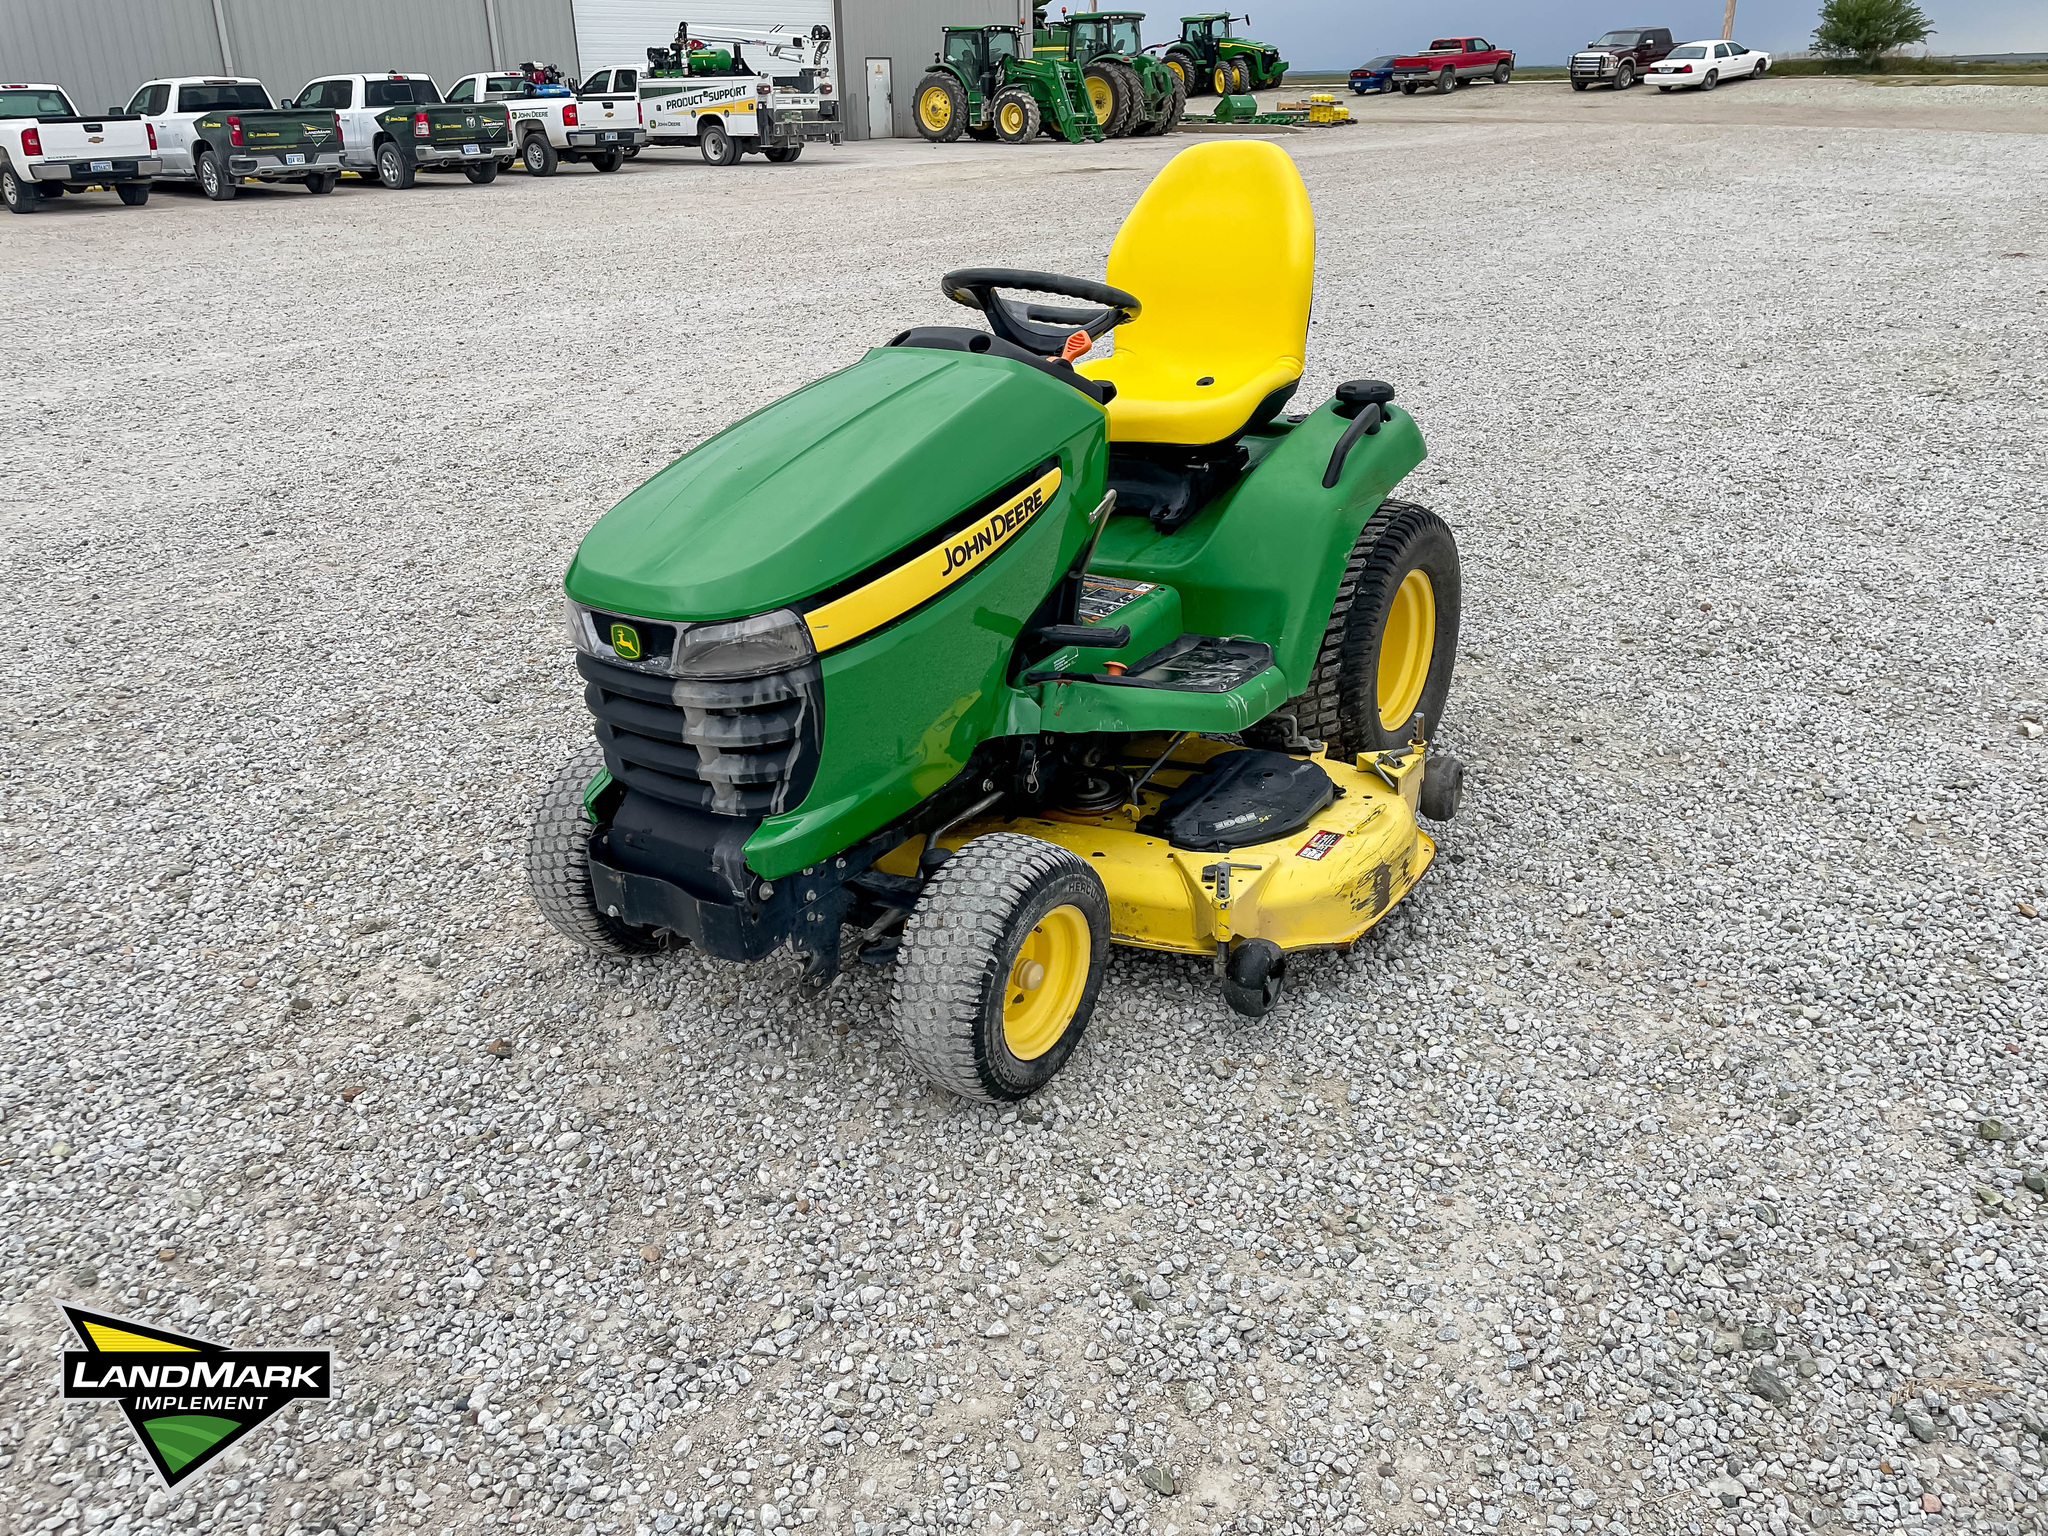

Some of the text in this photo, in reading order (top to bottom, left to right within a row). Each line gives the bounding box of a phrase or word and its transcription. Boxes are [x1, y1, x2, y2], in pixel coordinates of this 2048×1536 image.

[666, 85, 747, 110] PRODUCT SUPPORT
[532, 110, 548, 118] DEERE
[942, 487, 1043, 577] JOHN DEERE
[1213, 812, 1257, 831] EDGE
